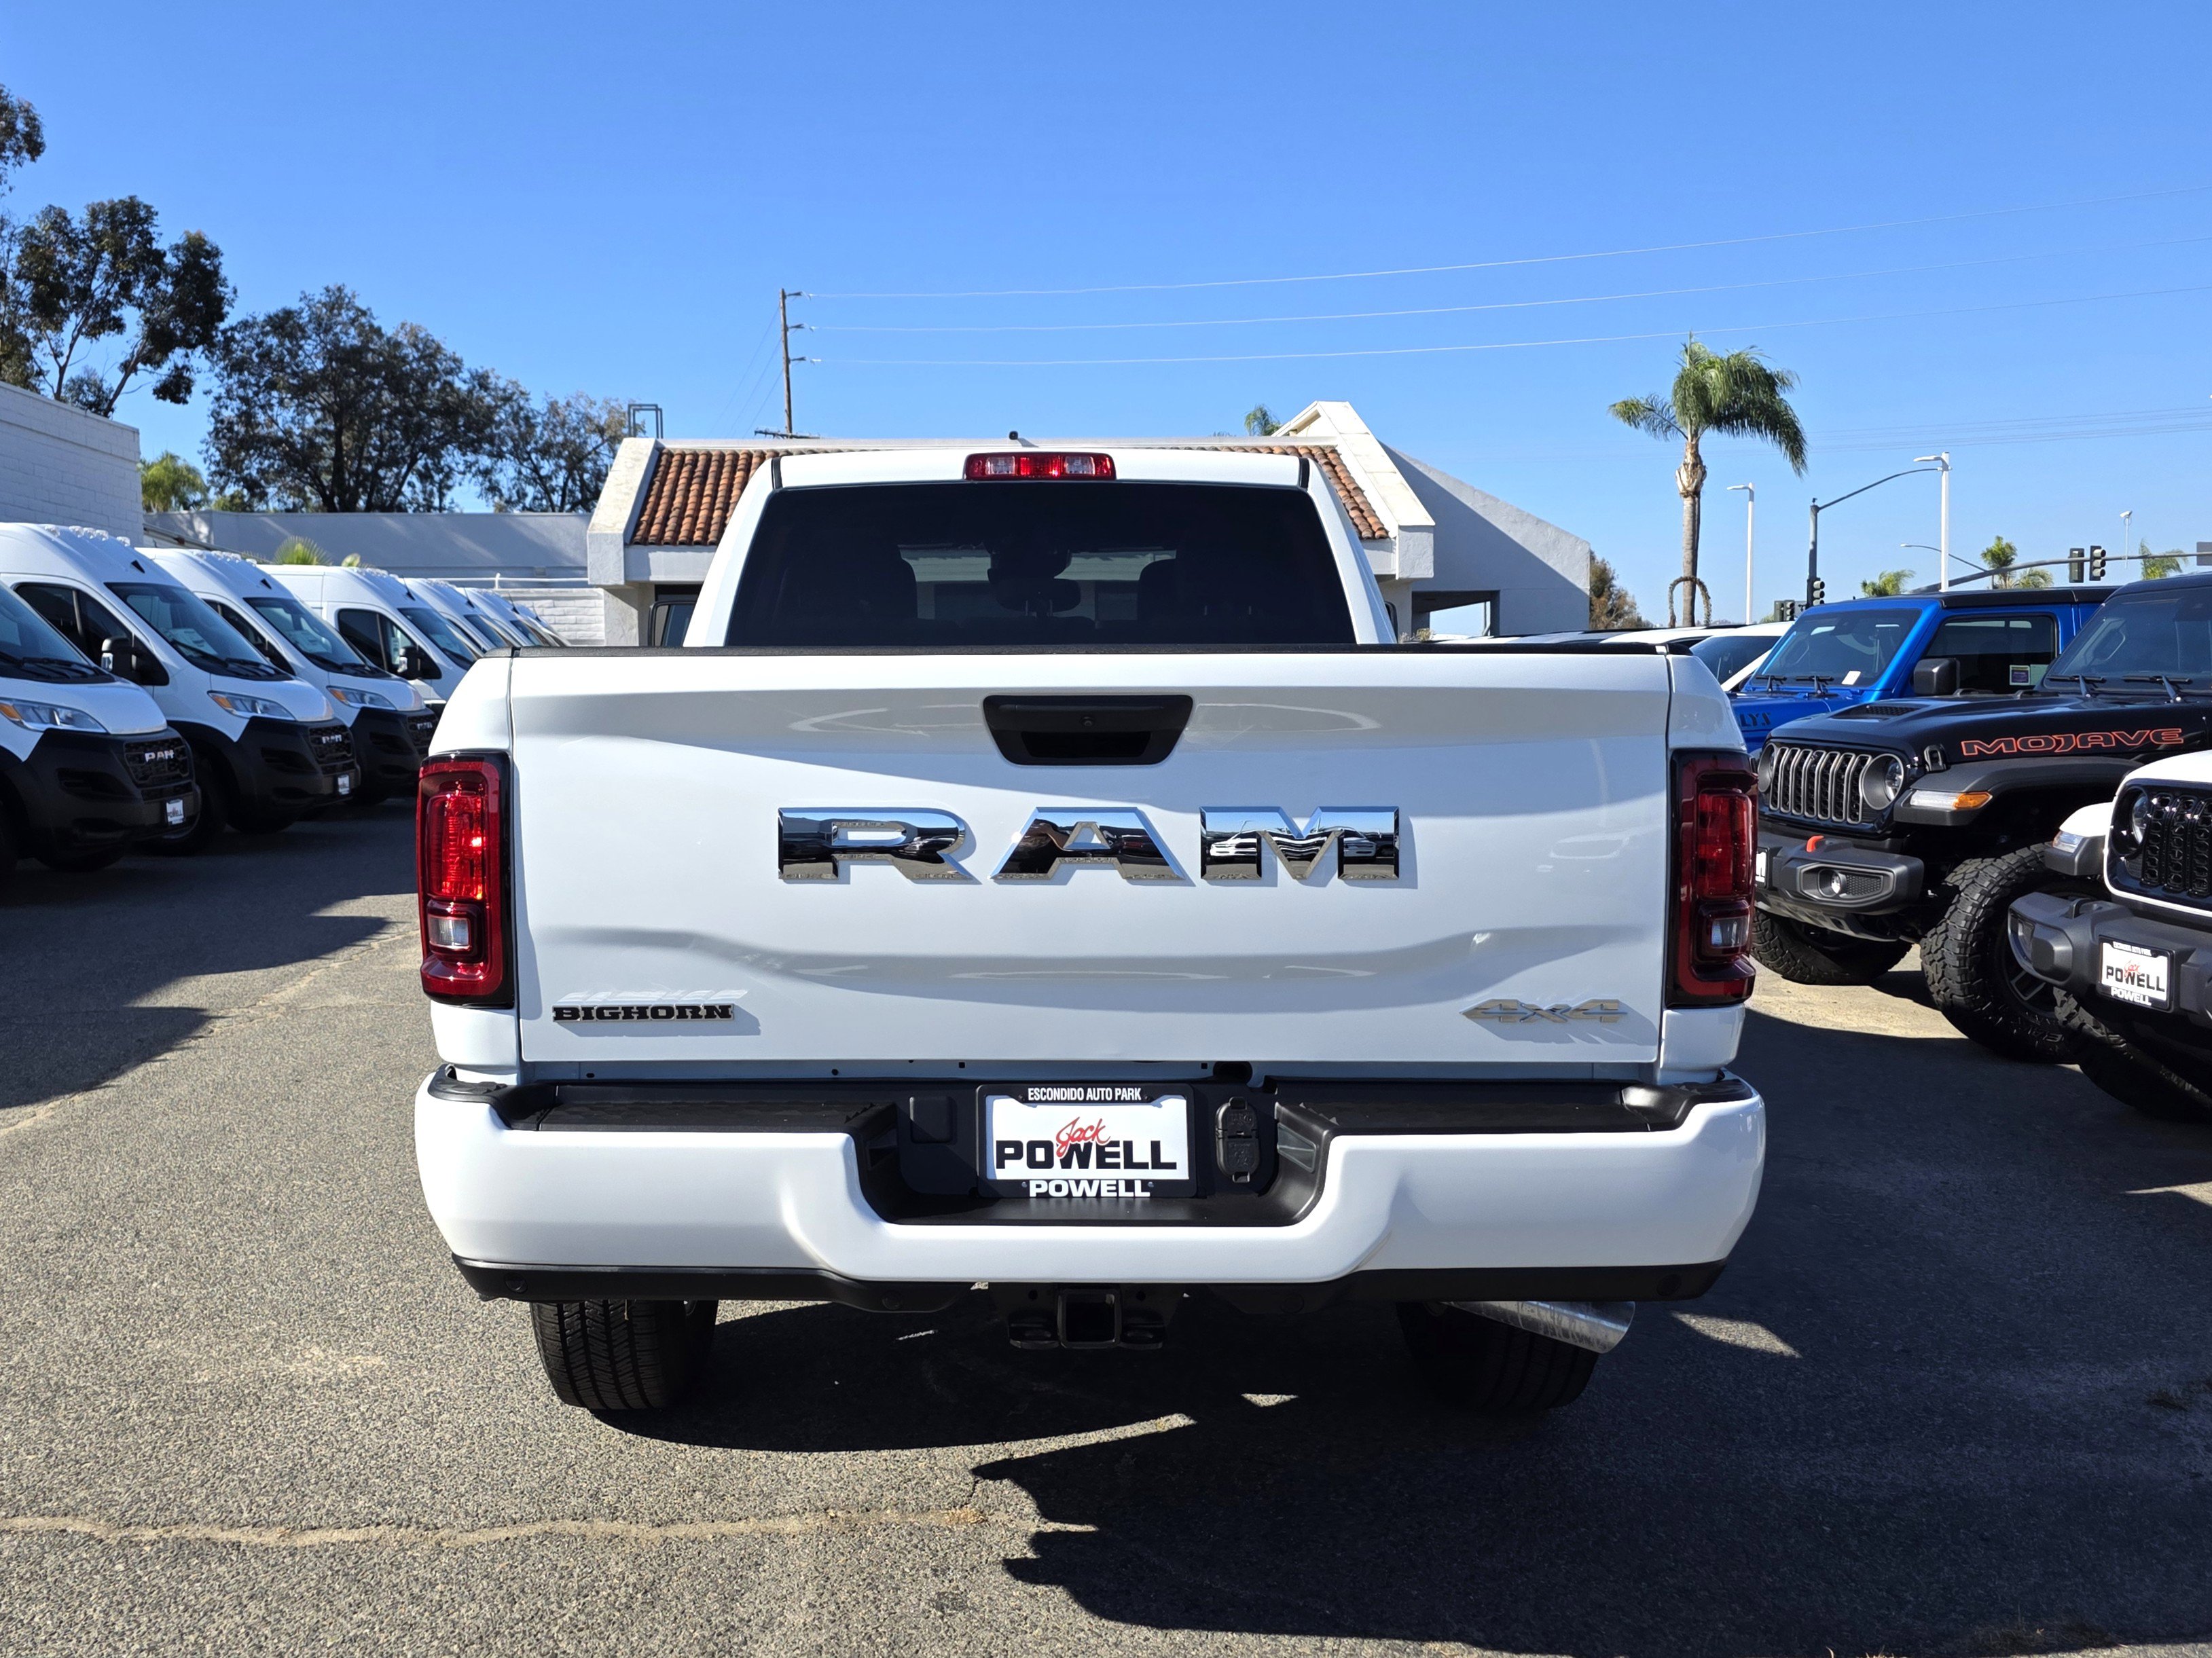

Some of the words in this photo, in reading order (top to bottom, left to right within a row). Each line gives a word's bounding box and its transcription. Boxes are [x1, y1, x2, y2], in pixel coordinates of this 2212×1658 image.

[1961, 728, 2183, 756] MOJAVE
[778, 807, 1400, 881] RAM
[2107, 965, 2165, 993] POWELL
[2111, 987, 2152, 1006] POWELL
[551, 1003, 735, 1022] BIGHORN
[1028, 1088, 1084, 1101] ESCONDIDO
[1087, 1088, 1112, 1101] AUTO
[1115, 1088, 1142, 1101] PARK
[1055, 1116, 1110, 1158] Jack
[996, 1140, 1177, 1170] POWELL
[1029, 1179, 1150, 1198] POWELL
